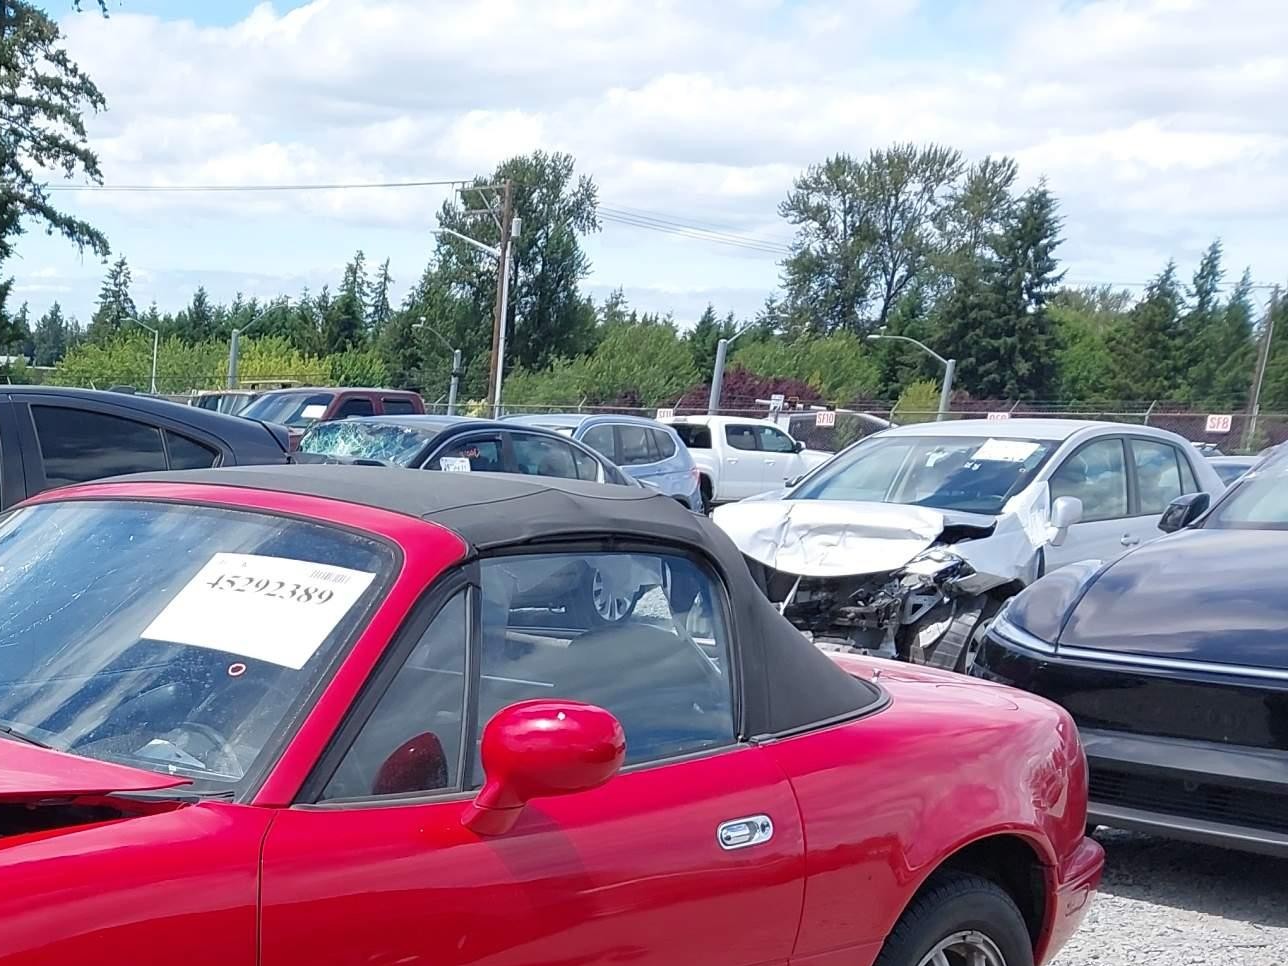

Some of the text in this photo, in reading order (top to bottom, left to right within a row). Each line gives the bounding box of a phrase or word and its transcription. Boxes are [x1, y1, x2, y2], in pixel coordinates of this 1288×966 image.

[817, 413, 834, 424] SF10
[1209, 416, 1230, 430] SF8
[206, 573, 335, 606] 45292389
